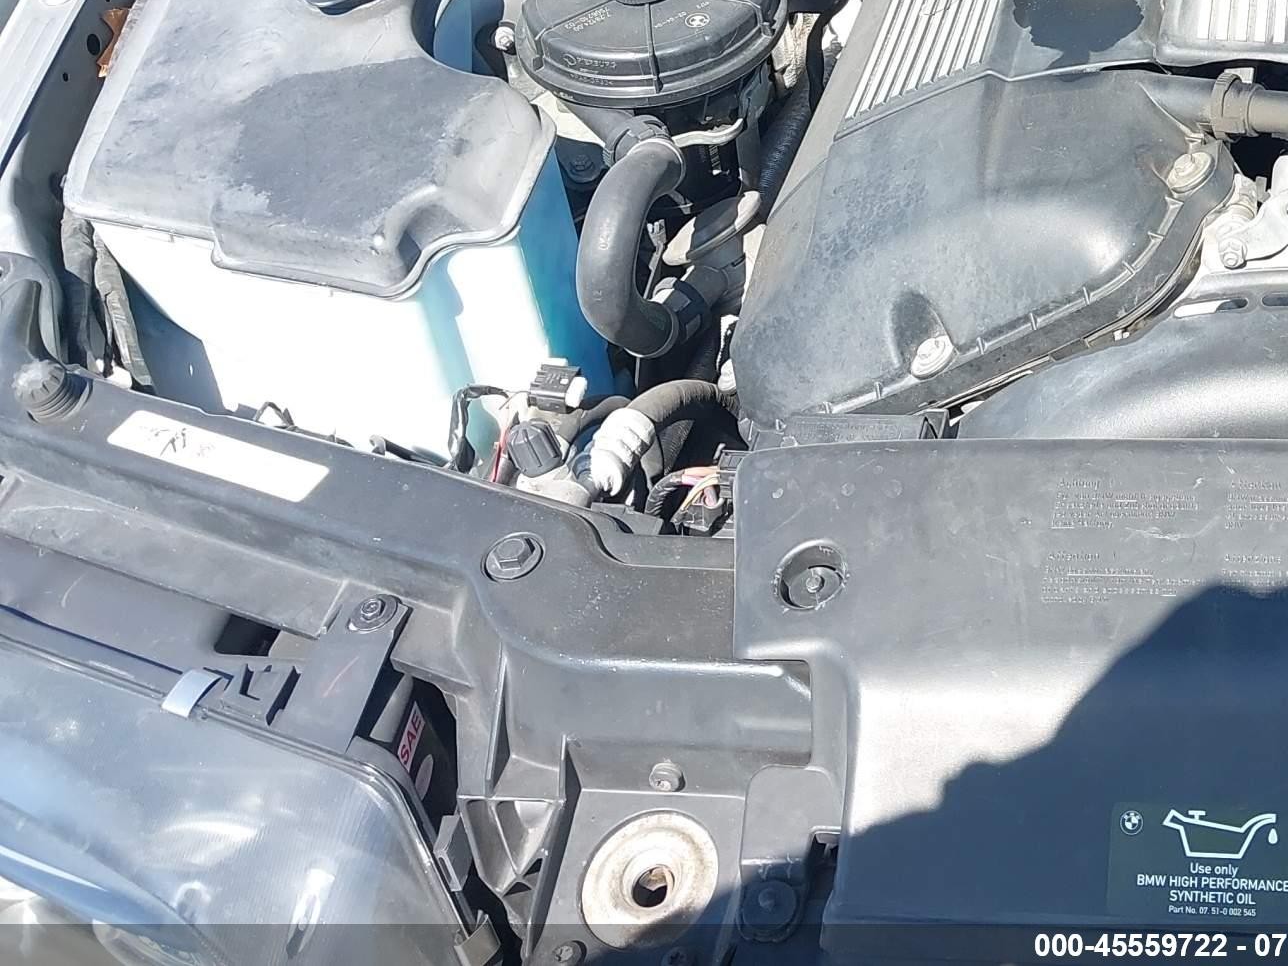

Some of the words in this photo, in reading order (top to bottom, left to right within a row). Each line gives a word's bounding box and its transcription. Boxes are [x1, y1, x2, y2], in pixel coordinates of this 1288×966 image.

[400, 713, 422, 765] SAE
[1190, 862, 1212, 875] Use
[1214, 863, 1239, 877] only
[1136, 874, 1167, 887] BMW
[1169, 875, 1198, 888] HIGH
[1169, 890, 1234, 904] SYNTHETIC
[1236, 893, 1256, 905] OIL
[1168, 905, 1184, 914] Part
[1185, 906, 1197, 915] No.
[1228, 907, 1242, 916] 002
